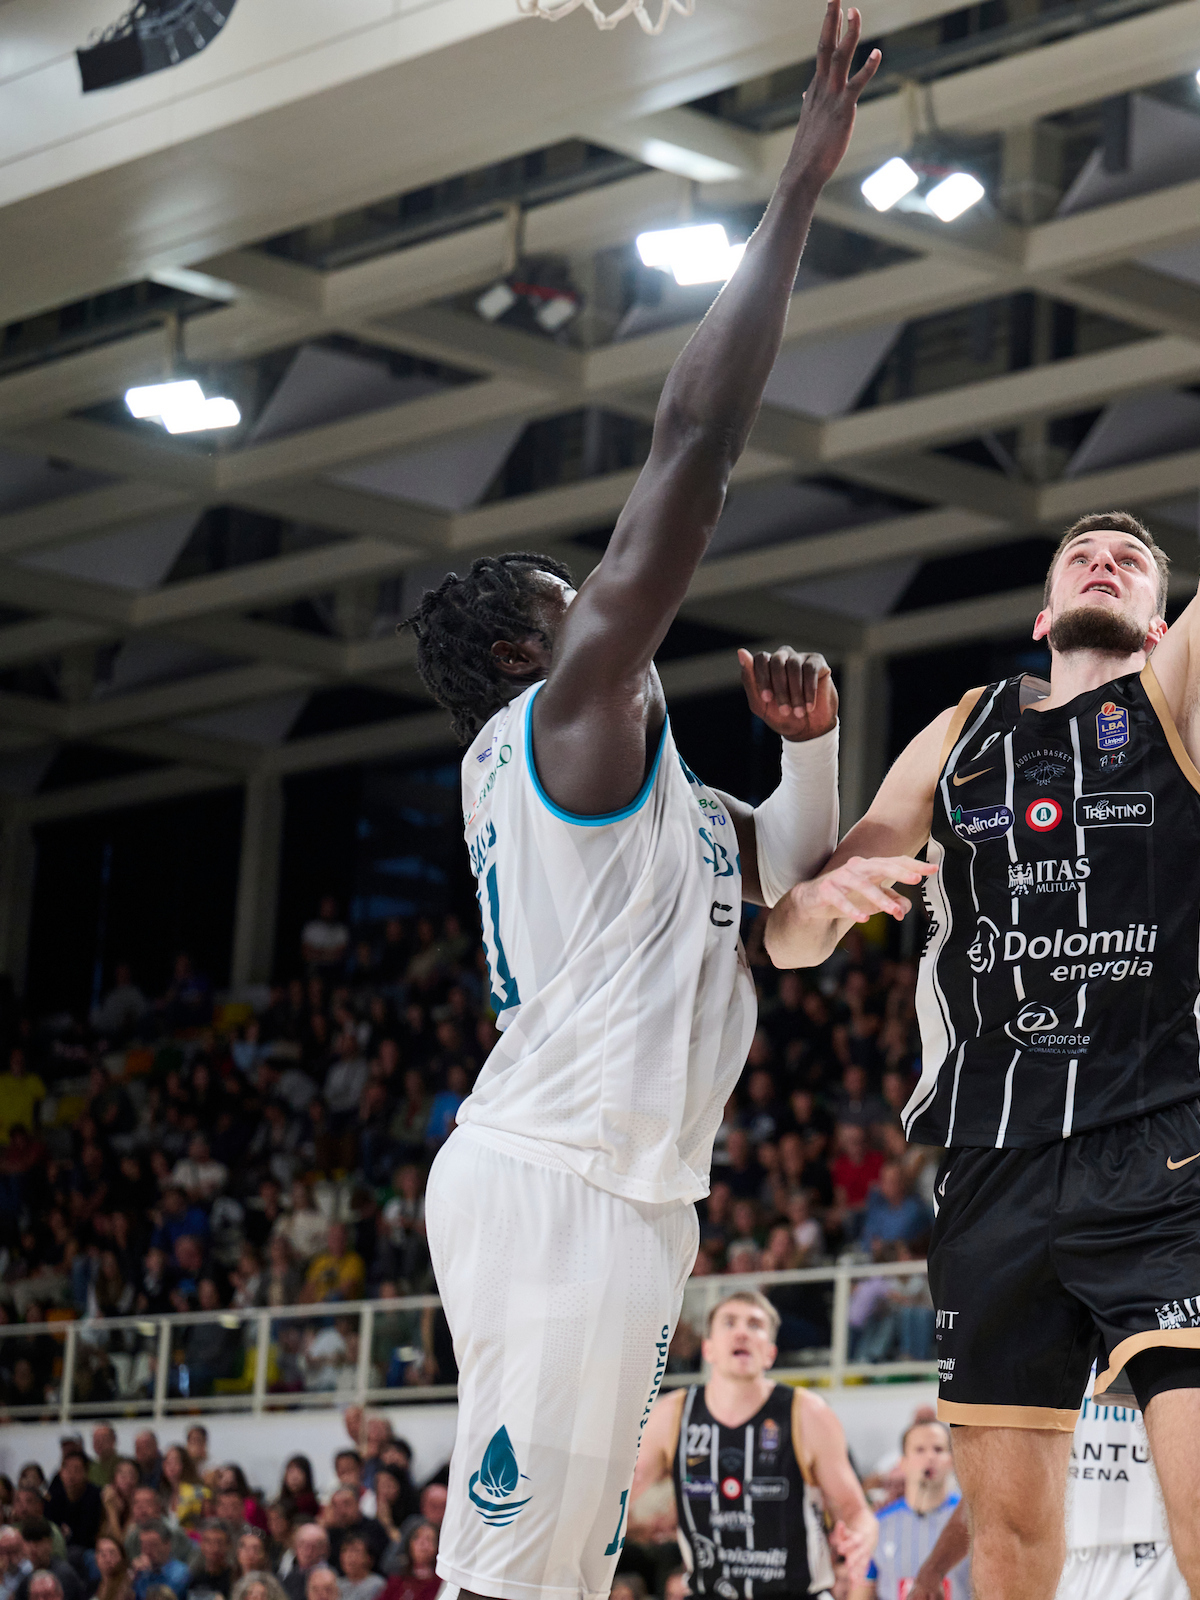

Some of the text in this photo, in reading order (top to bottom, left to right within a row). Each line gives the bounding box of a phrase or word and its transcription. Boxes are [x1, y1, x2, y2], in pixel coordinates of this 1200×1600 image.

[1101, 720, 1125, 733] LBA
[1104, 735, 1124, 746] Unipol
[1015, 748, 1073, 769] AQUILA BASKET
[1040, 808, 1048, 821] A
[1082, 802, 1147, 821] TRENTINO
[955, 812, 1010, 837] Melinda
[1036, 857, 1092, 882] ITAS
[1035, 881, 1078, 894] MUTUA
[1003, 924, 1158, 961] Dolomiti
[1050, 956, 1154, 982] energia
[1030, 1032, 1091, 1047] Corporate
[937, 1358, 956, 1371] miti
[938, 1371, 954, 1382] rgia
[687, 1423, 712, 1456] 22
[1069, 1466, 1130, 1482] RENA
